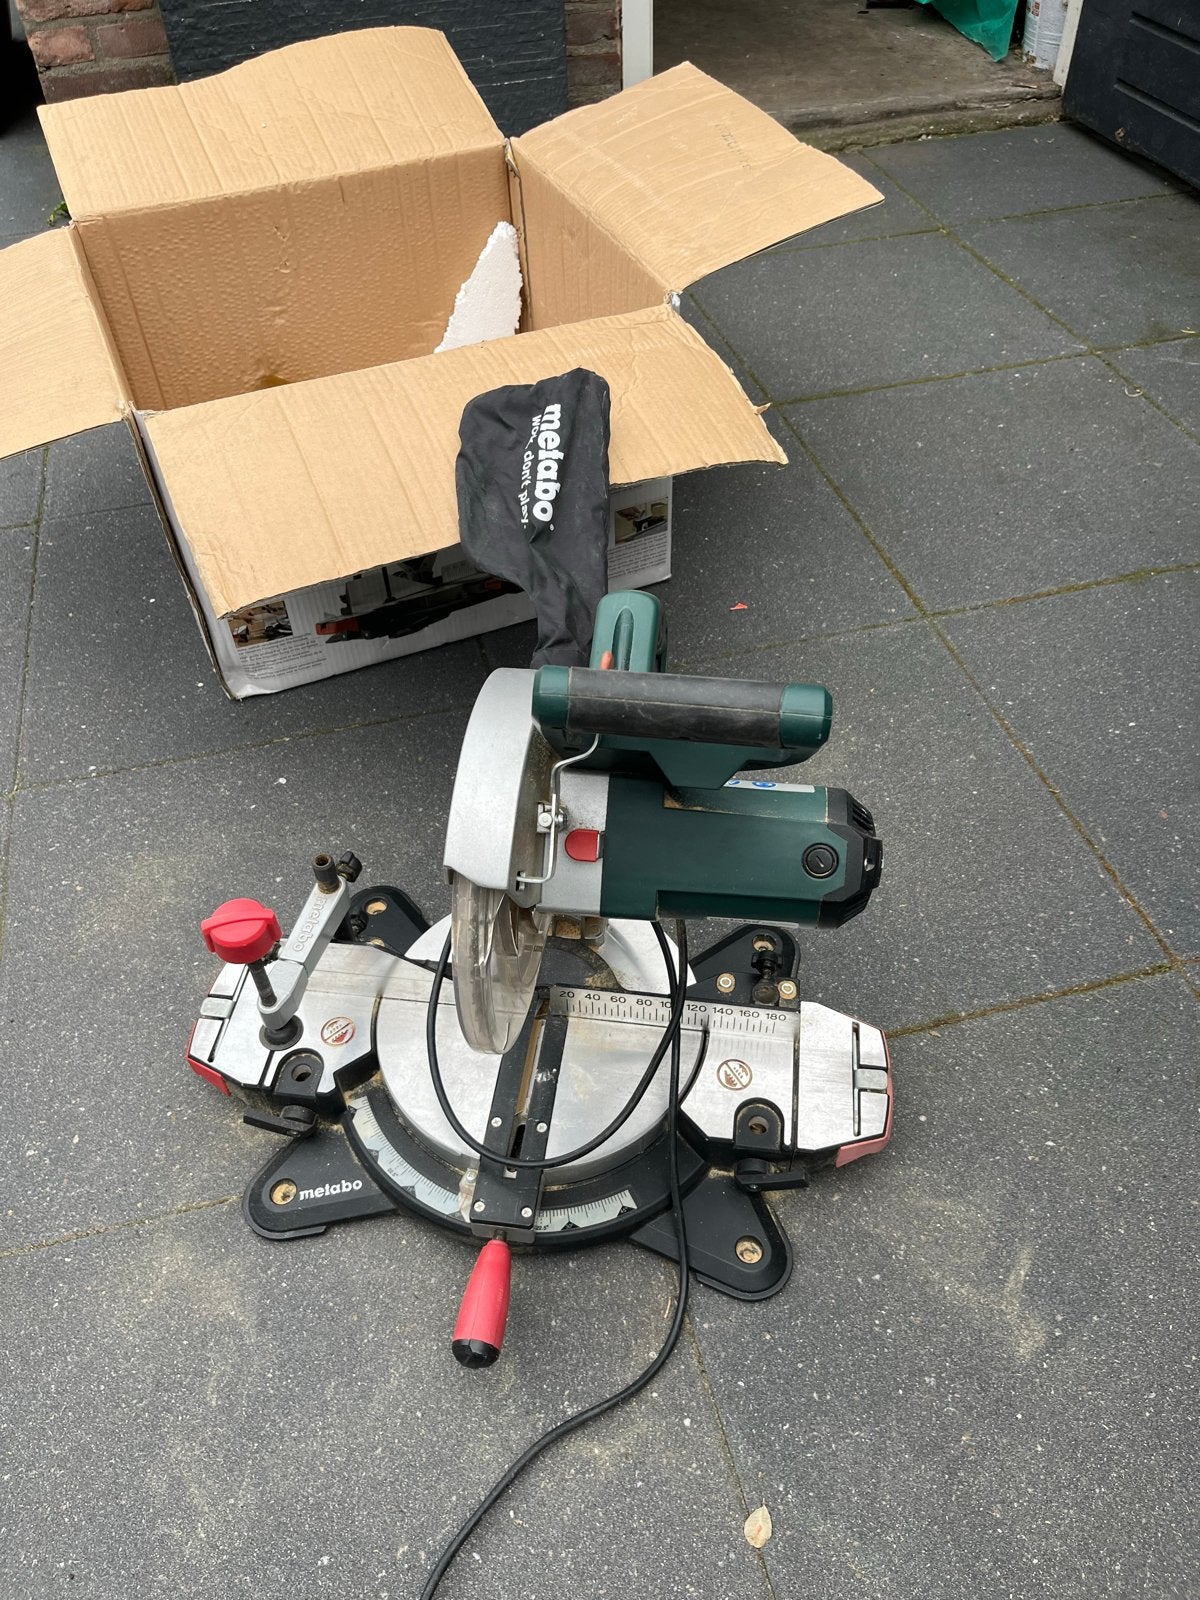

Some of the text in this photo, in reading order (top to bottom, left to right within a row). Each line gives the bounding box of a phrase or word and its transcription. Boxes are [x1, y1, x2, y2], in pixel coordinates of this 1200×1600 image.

[520, 450, 535, 489] don't
[532, 403, 564, 522] metabo
[292, 896, 327, 952] metabo
[559, 990, 787, 1022] 20 40 60 80 10 120 140 160 180
[299, 1179, 363, 1201] metabo
